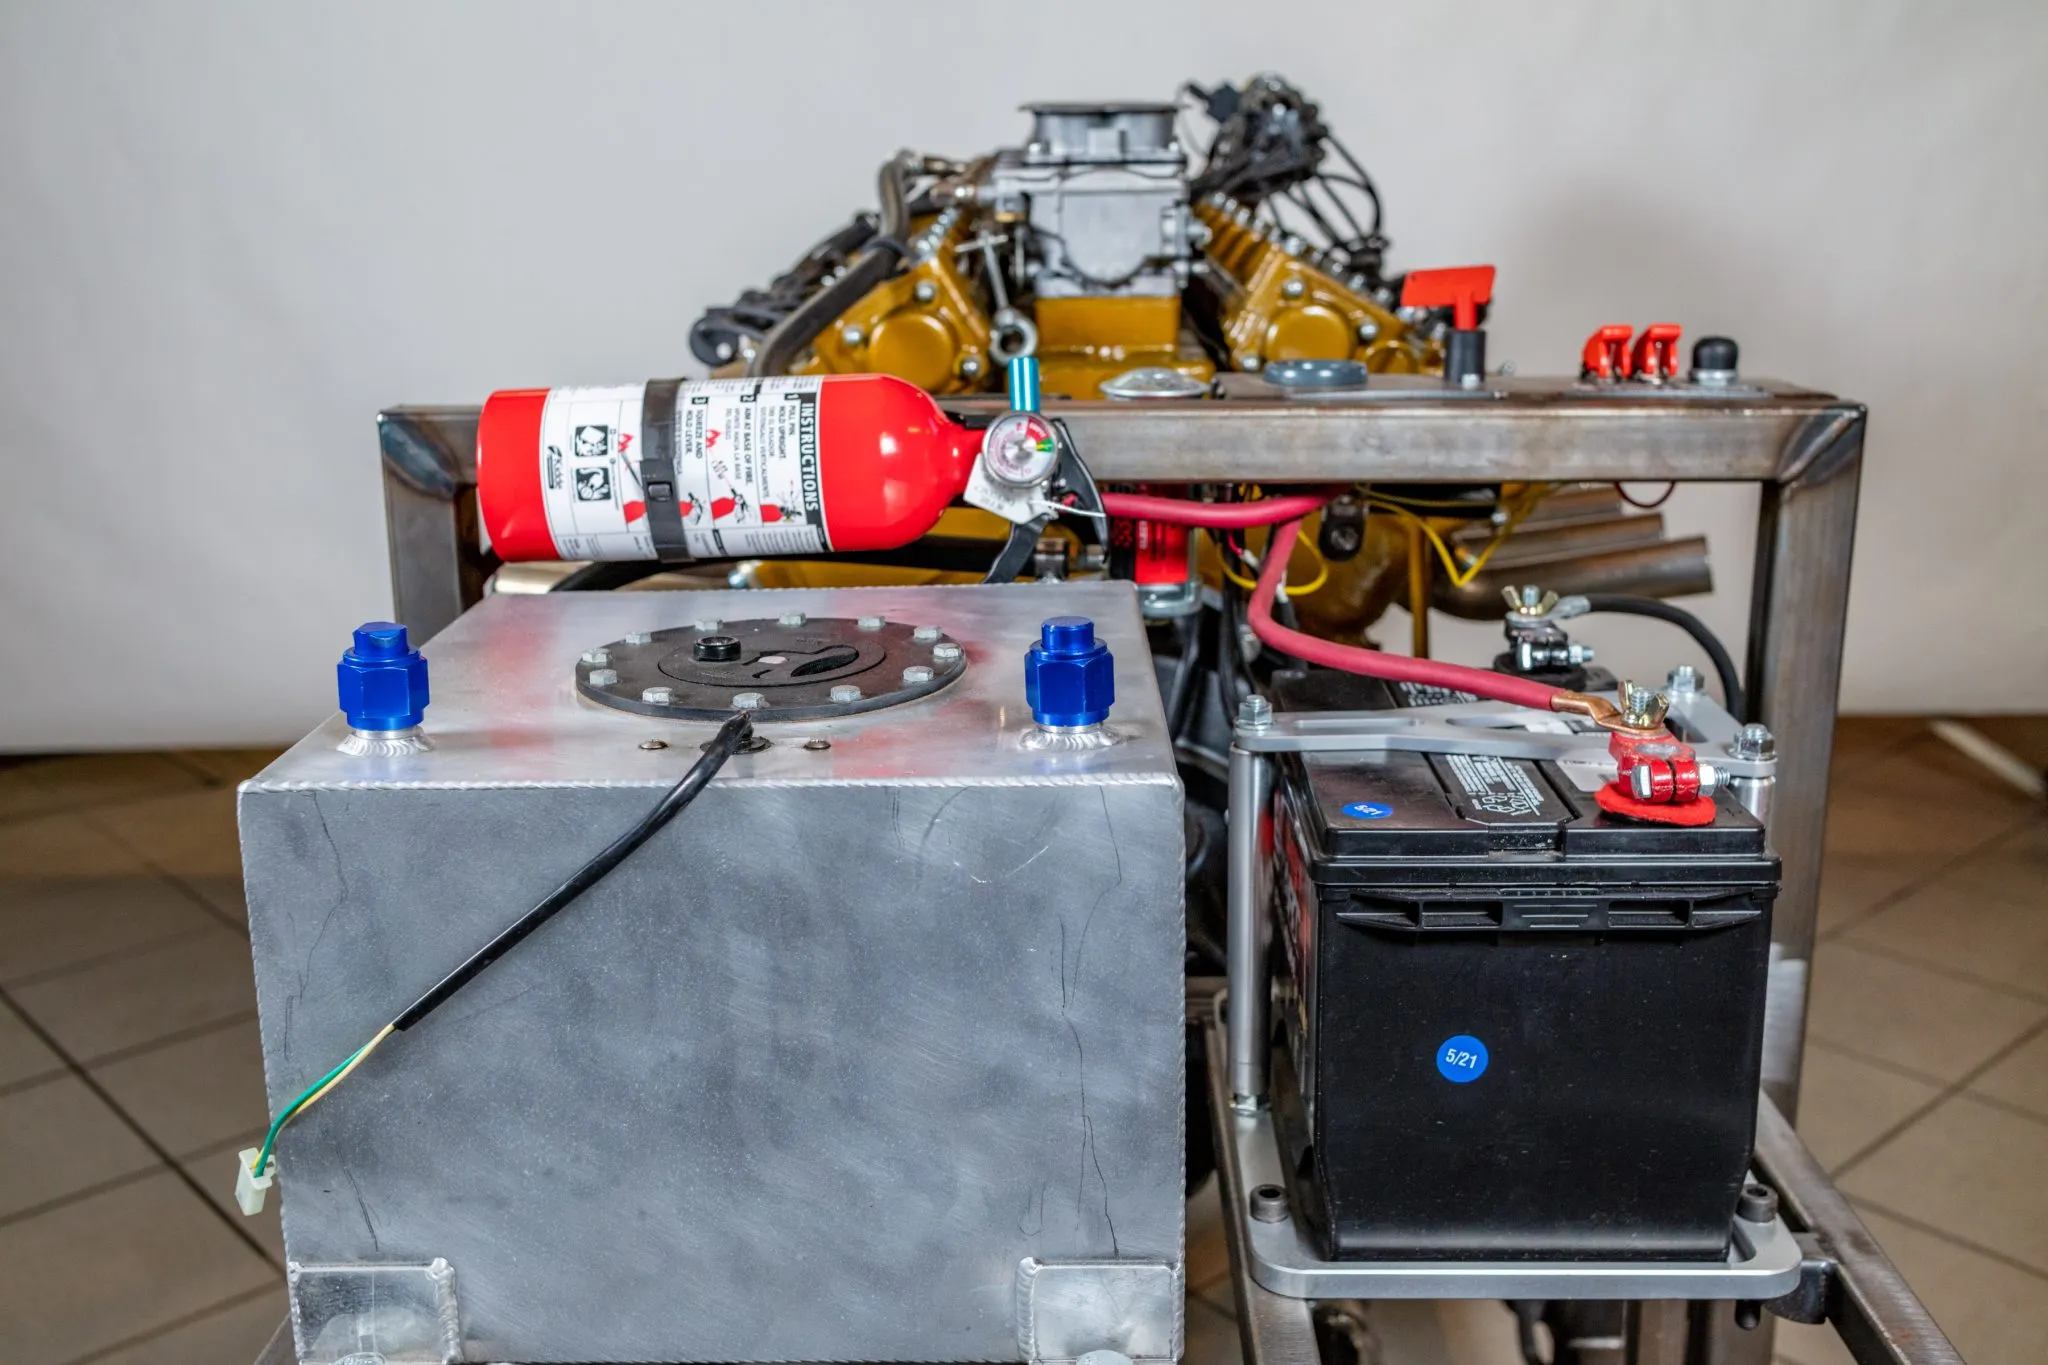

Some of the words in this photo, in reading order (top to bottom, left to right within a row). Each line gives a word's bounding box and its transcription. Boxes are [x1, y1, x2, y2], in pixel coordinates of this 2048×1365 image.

[685, 410, 693, 428] HOLD
[778, 406, 786, 424] HOLD
[788, 405, 796, 420] PULL
[695, 409, 703, 440] SQUEEZE
[744, 422, 751, 430] AT
[788, 422, 796, 437] PIN.
[685, 430, 693, 455] LEVER.
[695, 441, 703, 459] AND
[744, 454, 752, 465] OF
[800, 403, 819, 511] INSTRUCTIONS
[745, 466, 753, 485] FIRE.
[1445, 1048, 1478, 1069] 5/21
